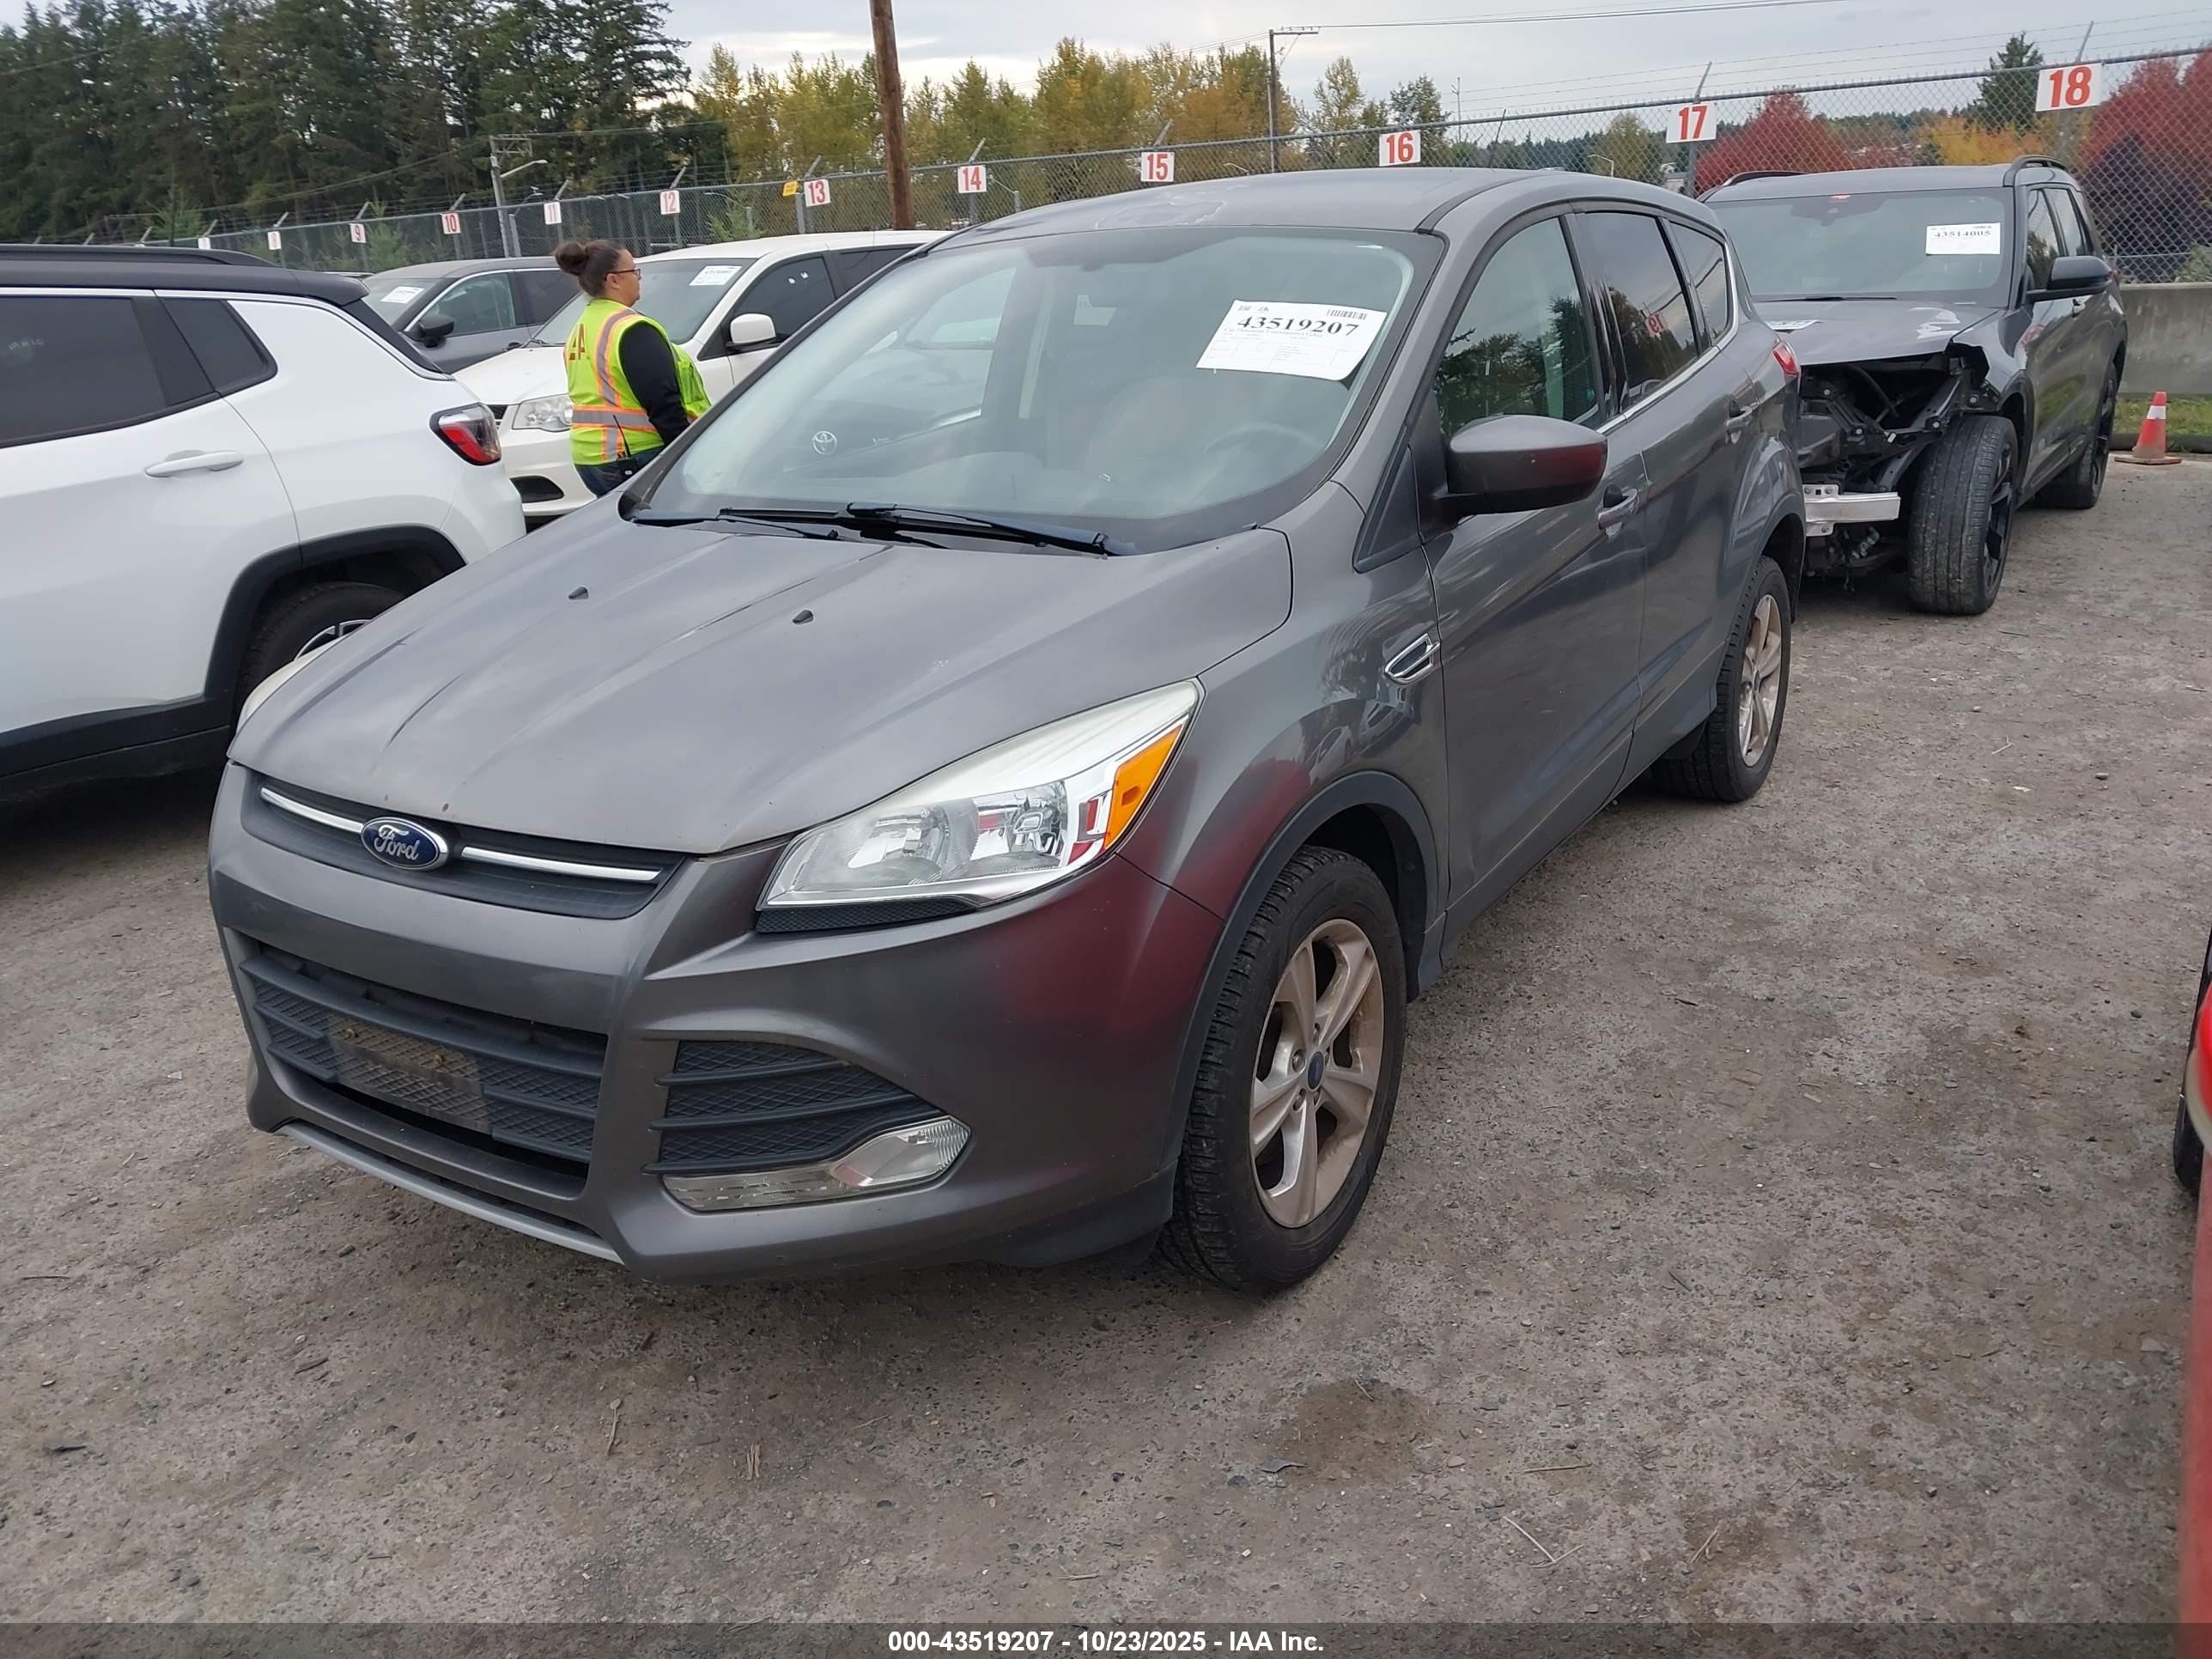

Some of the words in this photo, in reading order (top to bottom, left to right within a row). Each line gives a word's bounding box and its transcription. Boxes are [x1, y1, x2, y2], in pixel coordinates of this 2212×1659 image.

[2050, 66, 2092, 108] 18
[1679, 106, 1707, 140] 17
[1387, 132, 1413, 163] 16
[1147, 153, 1168, 180] 15
[963, 167, 981, 191] 14
[663, 191, 676, 213] 12
[809, 180, 825, 204] 13
[445, 214, 457, 233] 10
[548, 204, 557, 222] 11
[355, 224, 361, 241] 9
[1237, 315, 1360, 336] 43519207
[374, 824, 421, 860] Ford
